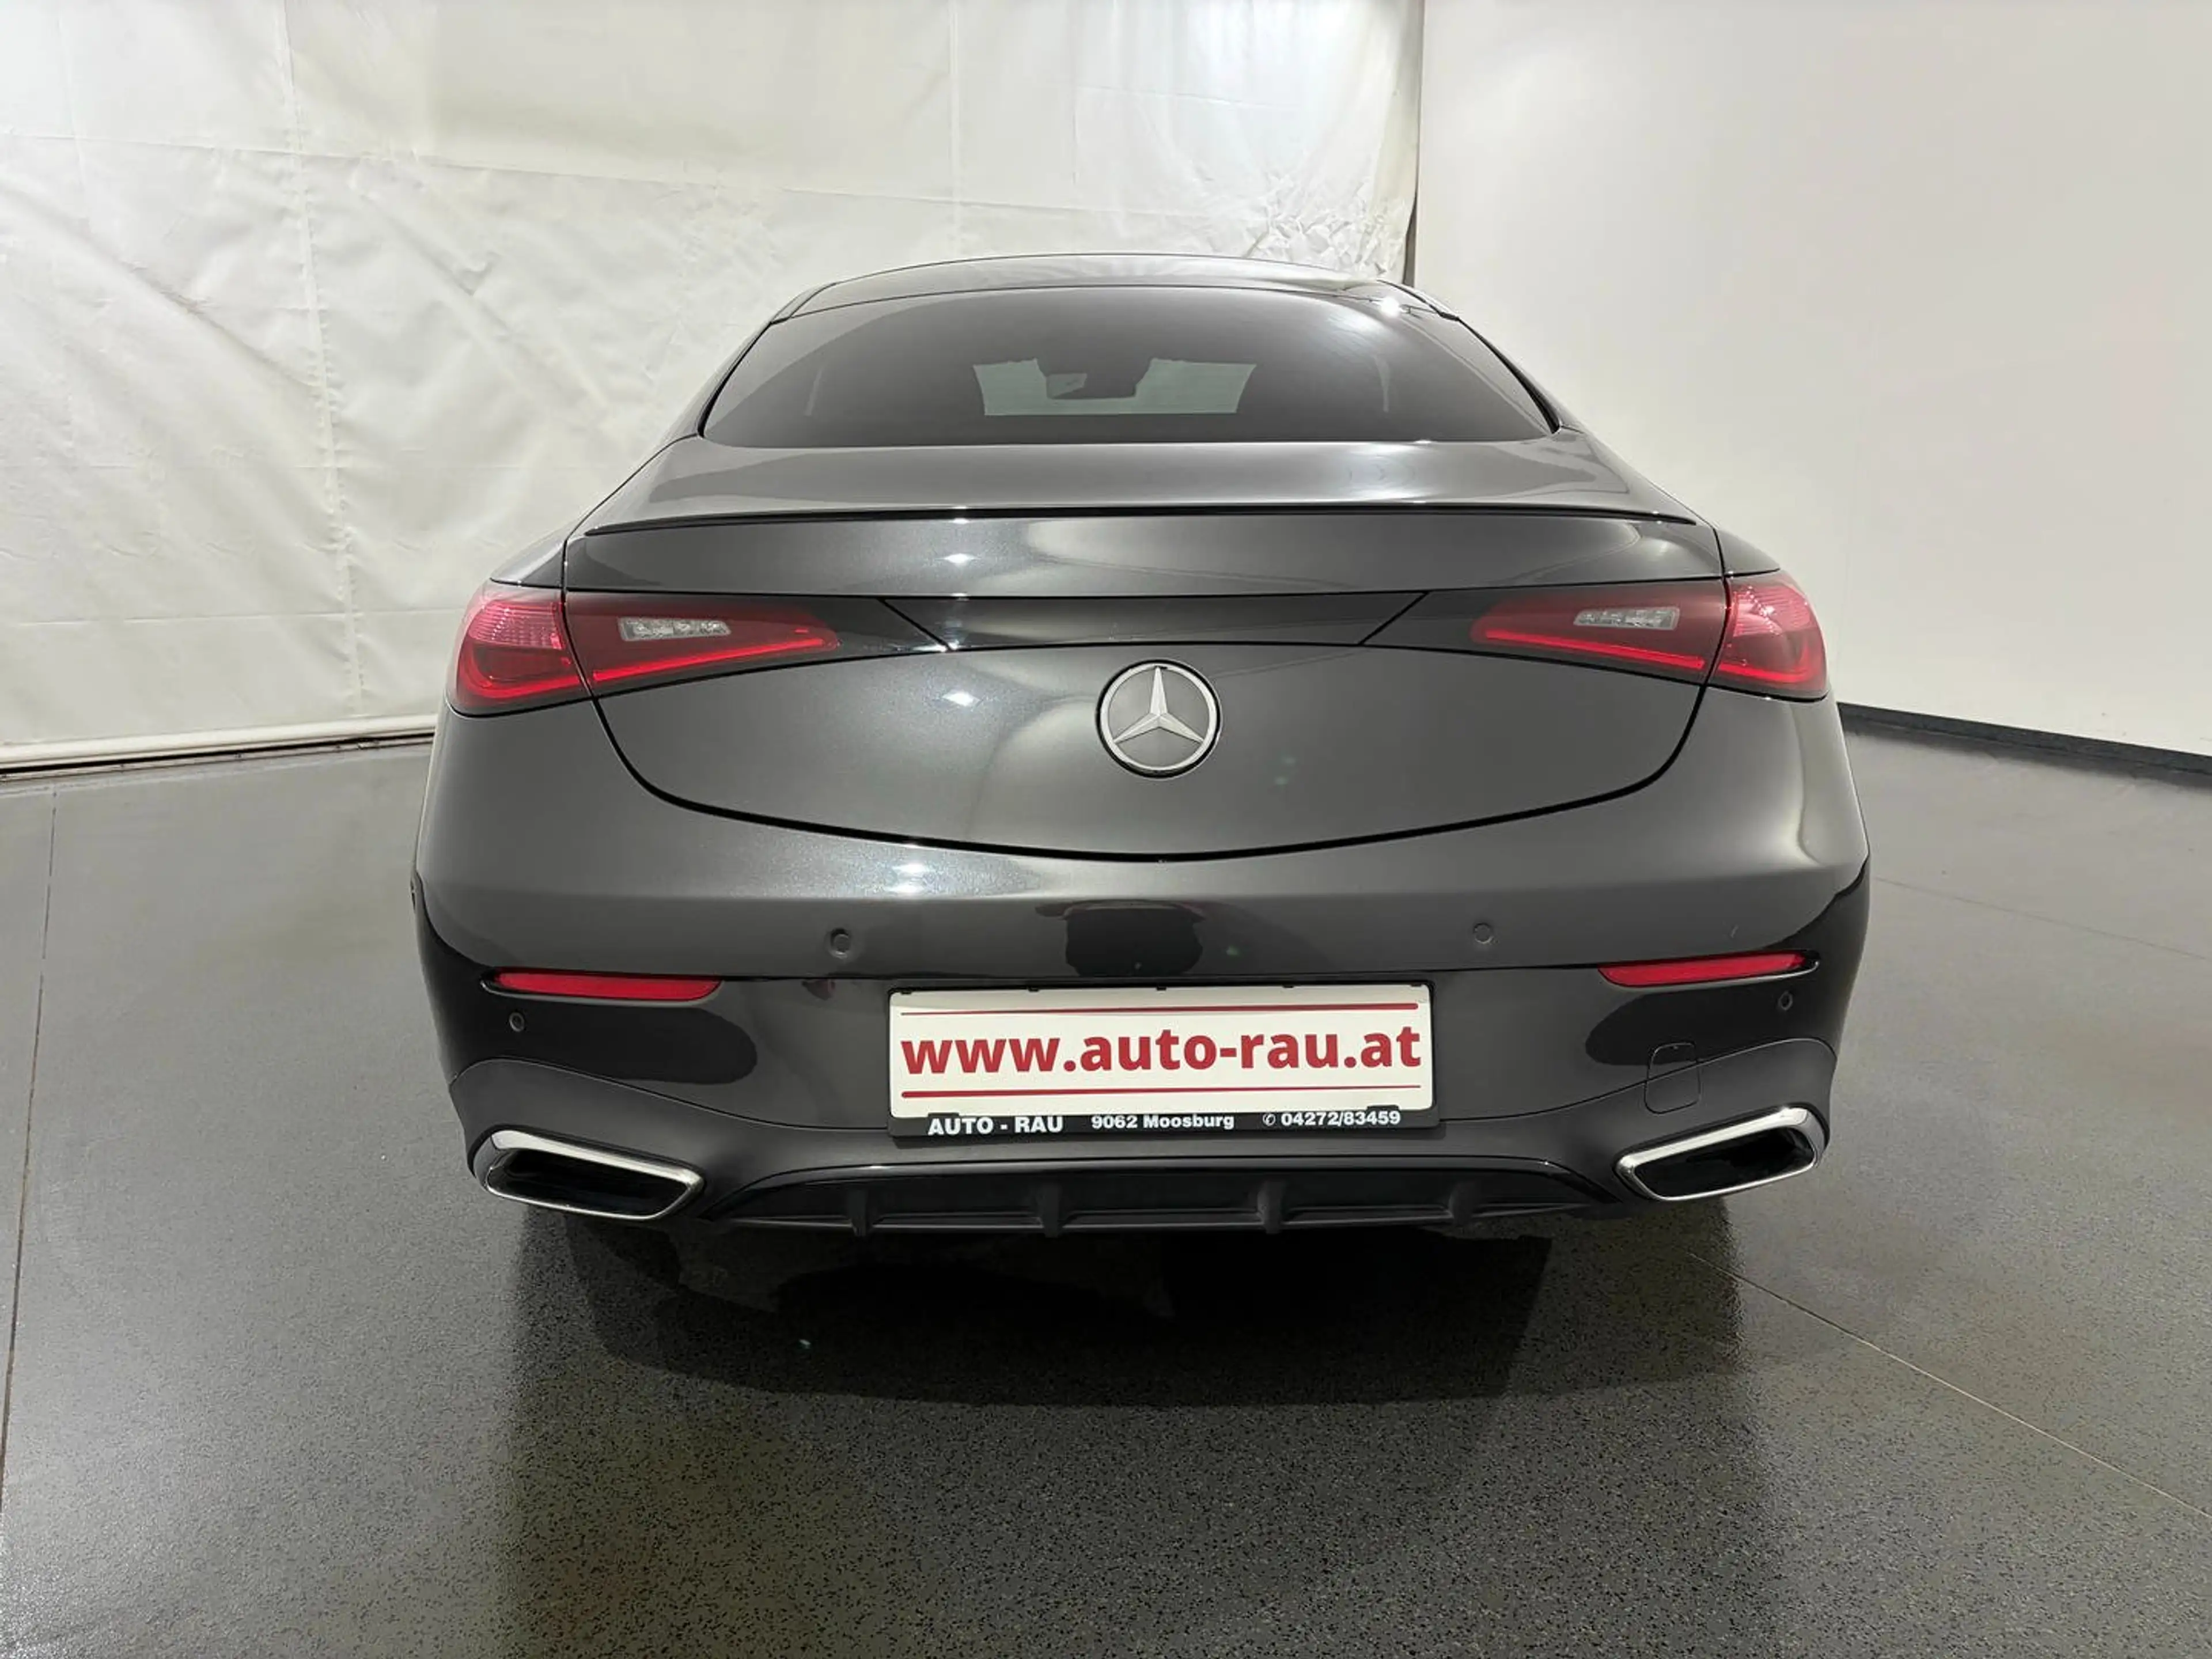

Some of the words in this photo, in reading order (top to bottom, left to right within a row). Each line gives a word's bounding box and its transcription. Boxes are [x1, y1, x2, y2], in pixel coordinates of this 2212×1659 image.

[901, 1025, 1421, 1075] www.auto-rau.at
[927, 1118, 994, 1135] AUTO
[1014, 1116, 1064, 1133] RAU
[1091, 1116, 1138, 1129] 9062
[1143, 1113, 1234, 1130] Moosburg
[1281, 1110, 1401, 1126] 04272/83459
